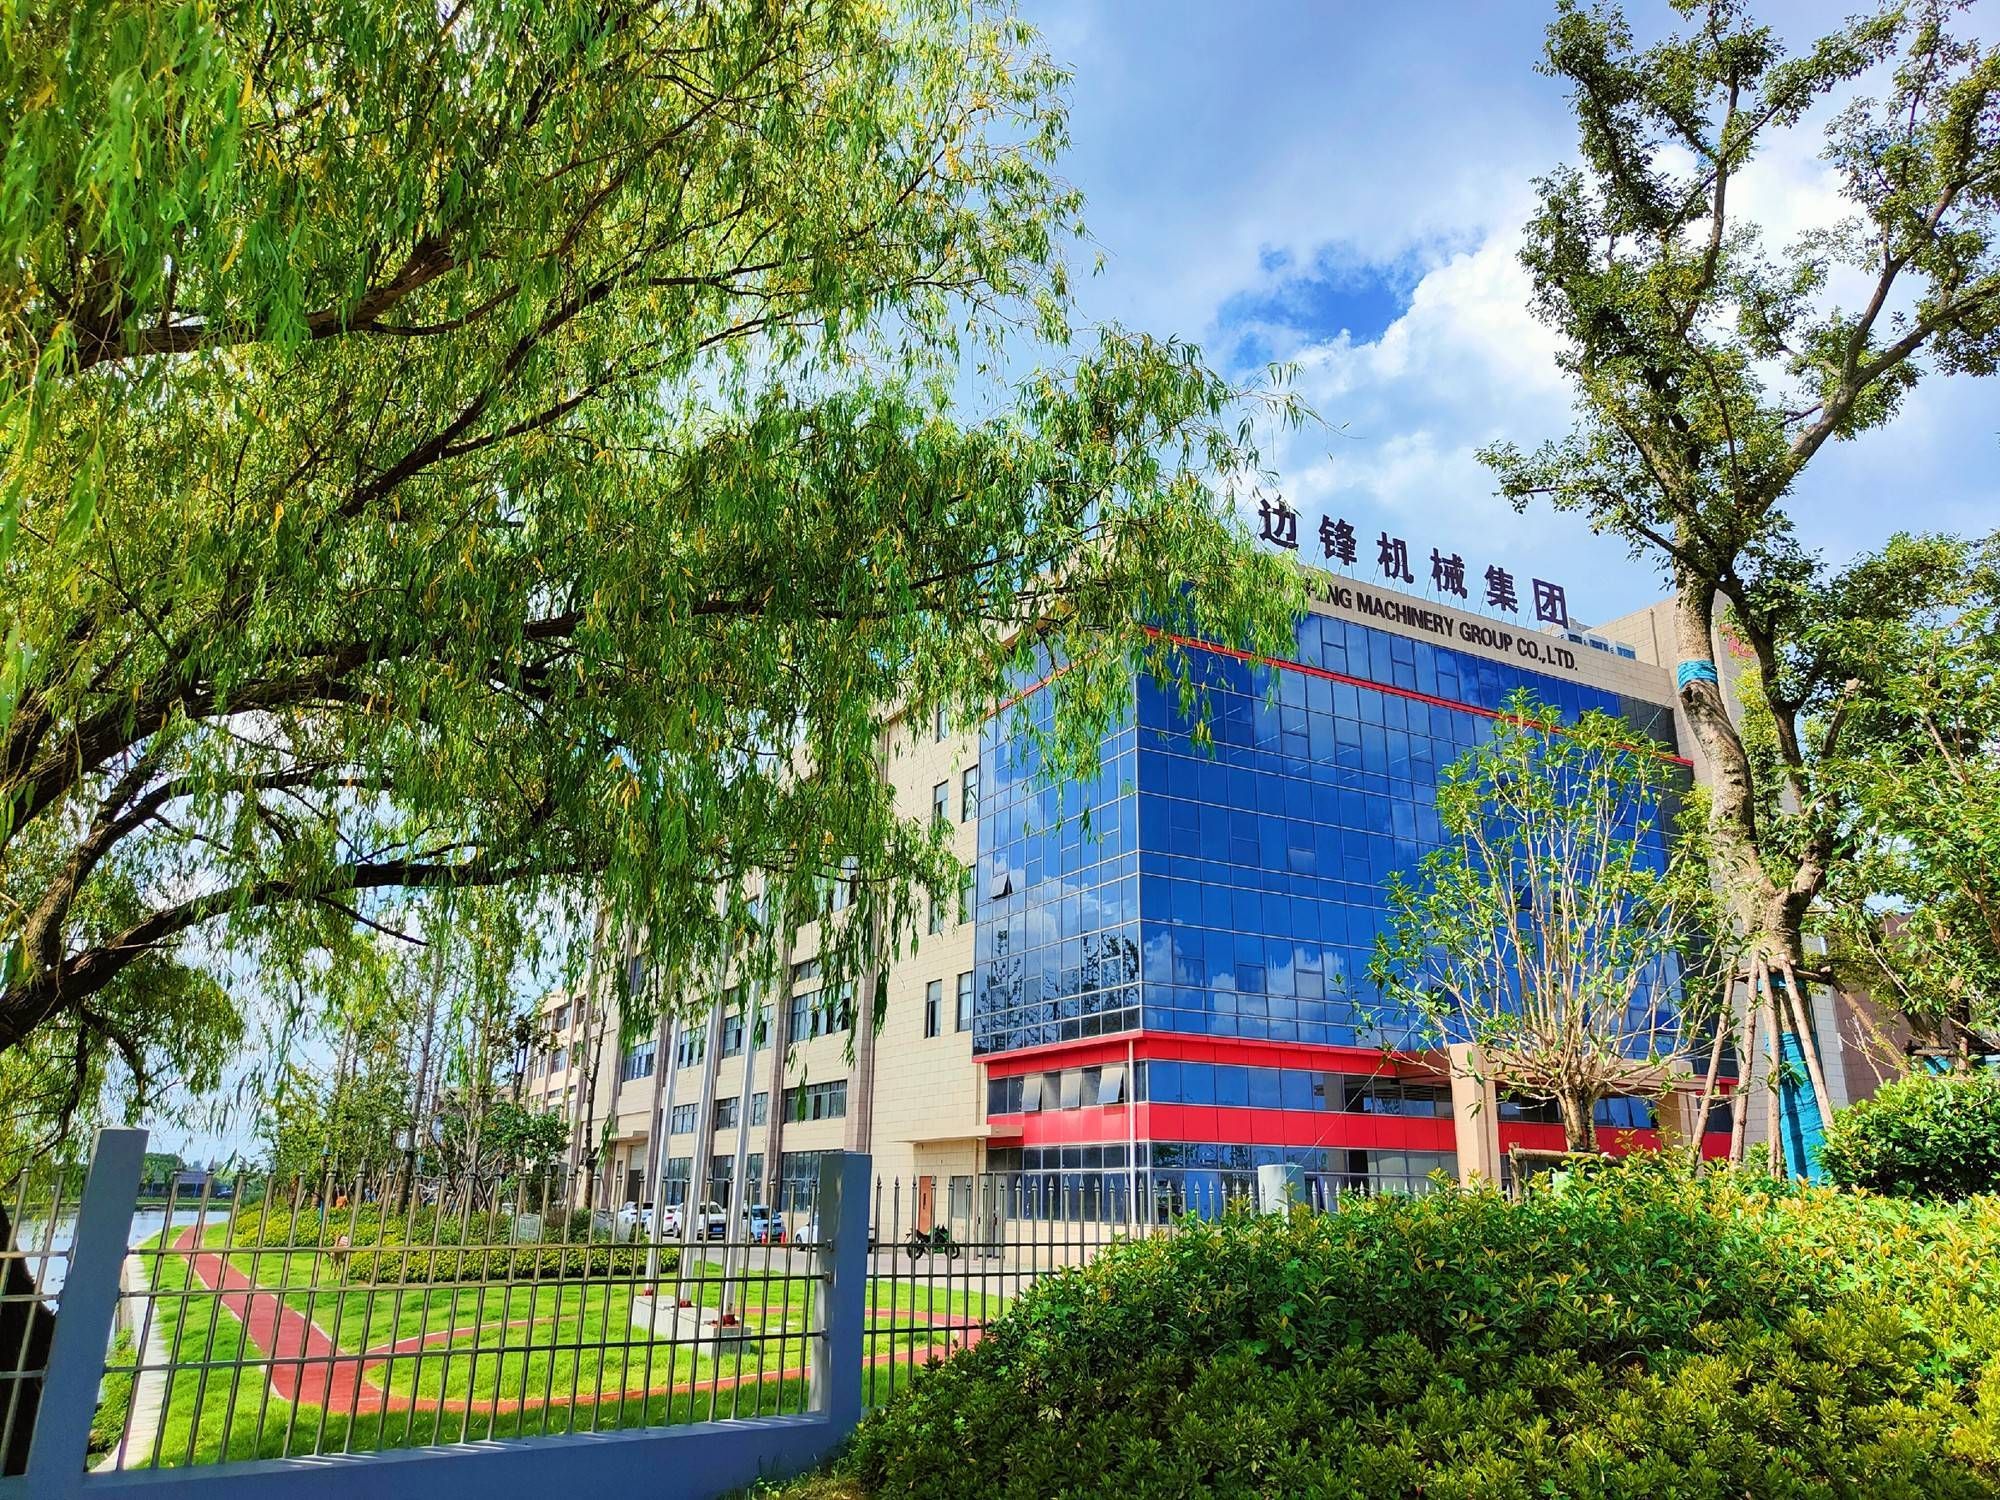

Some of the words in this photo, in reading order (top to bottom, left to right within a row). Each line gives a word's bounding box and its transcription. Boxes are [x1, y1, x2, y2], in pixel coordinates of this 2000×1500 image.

[1258, 495, 1568, 628] 边锋机械集团
[1356, 592, 1454, 637] MACHINERY
[1459, 621, 1513, 651] GROUP
